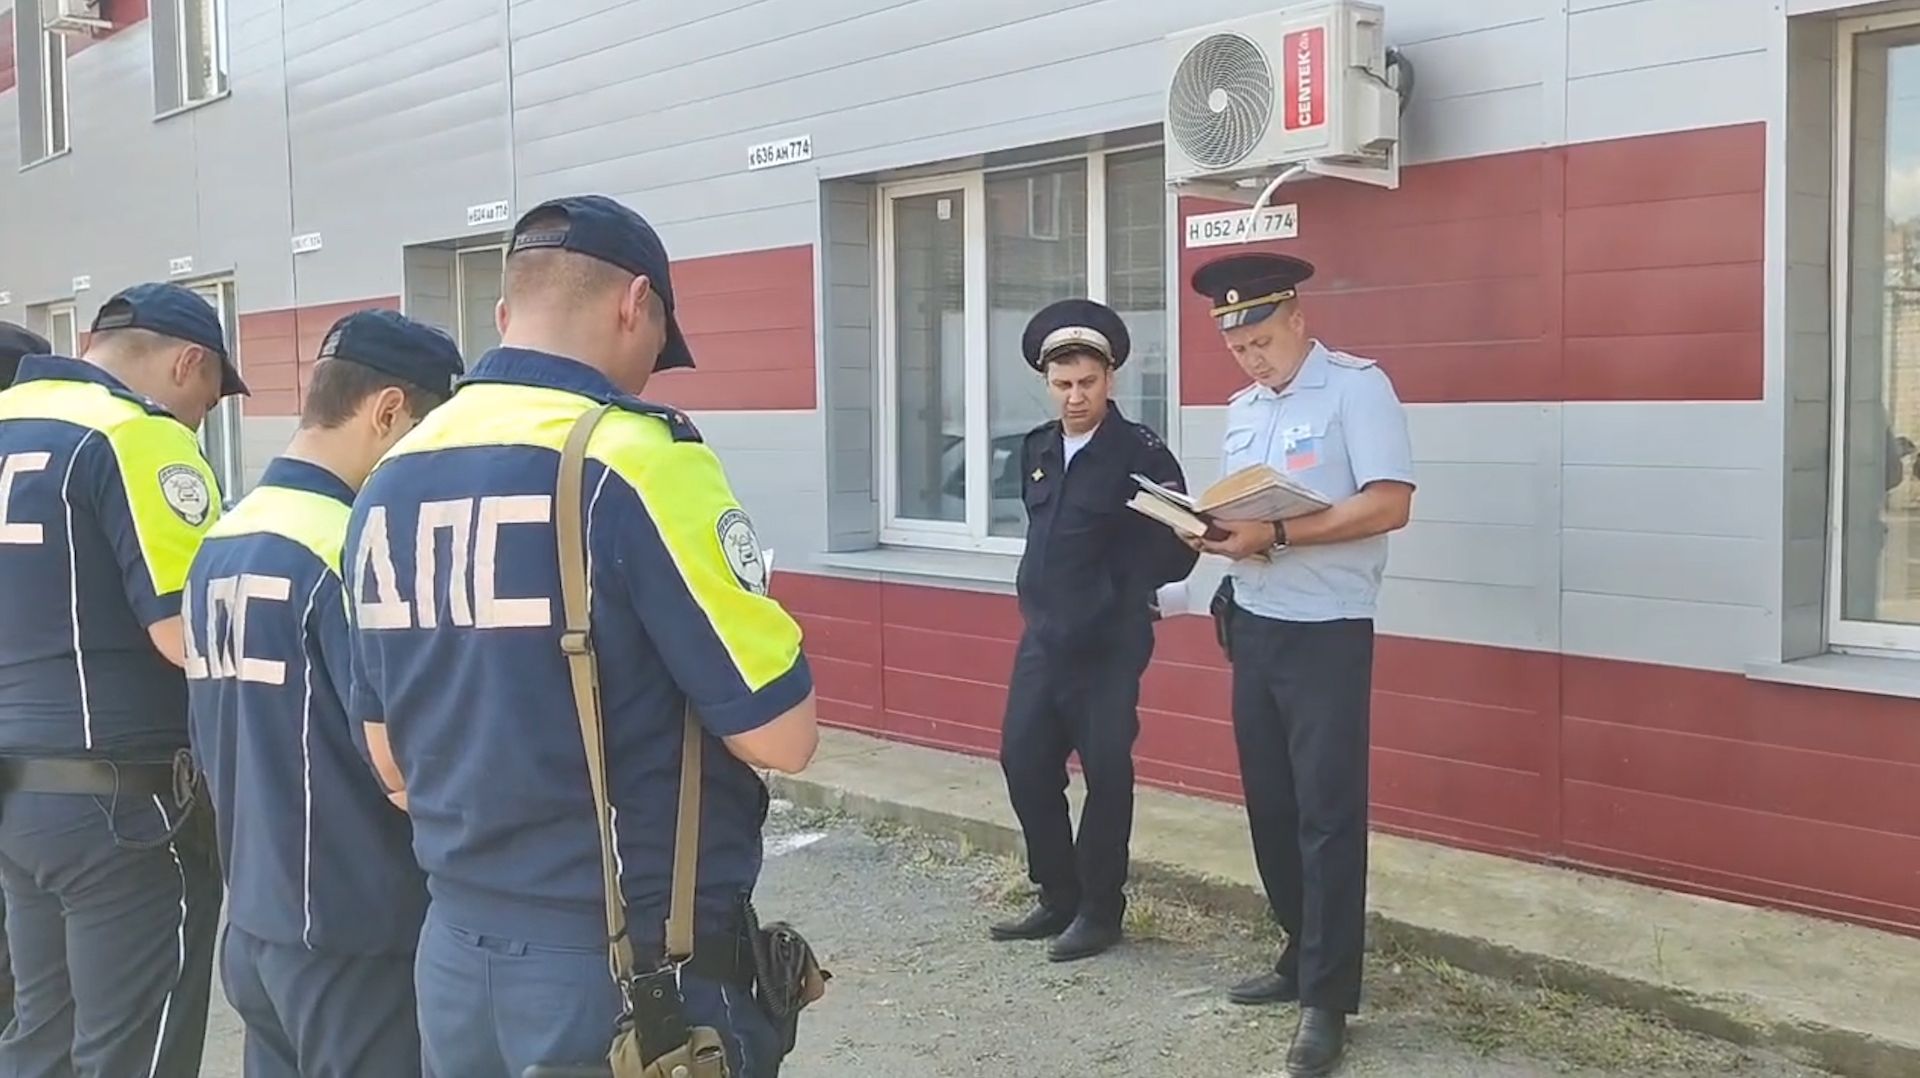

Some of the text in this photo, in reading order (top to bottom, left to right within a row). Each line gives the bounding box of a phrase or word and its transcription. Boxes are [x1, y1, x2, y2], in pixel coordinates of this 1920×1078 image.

[1298, 49, 1312, 126] CENTEK
[789, 139, 809, 159] 774
[1204, 221, 1231, 239] 052
[1264, 213, 1294, 232] 774
[0, 452, 51, 544] С
[353, 494, 552, 629] ДПС
